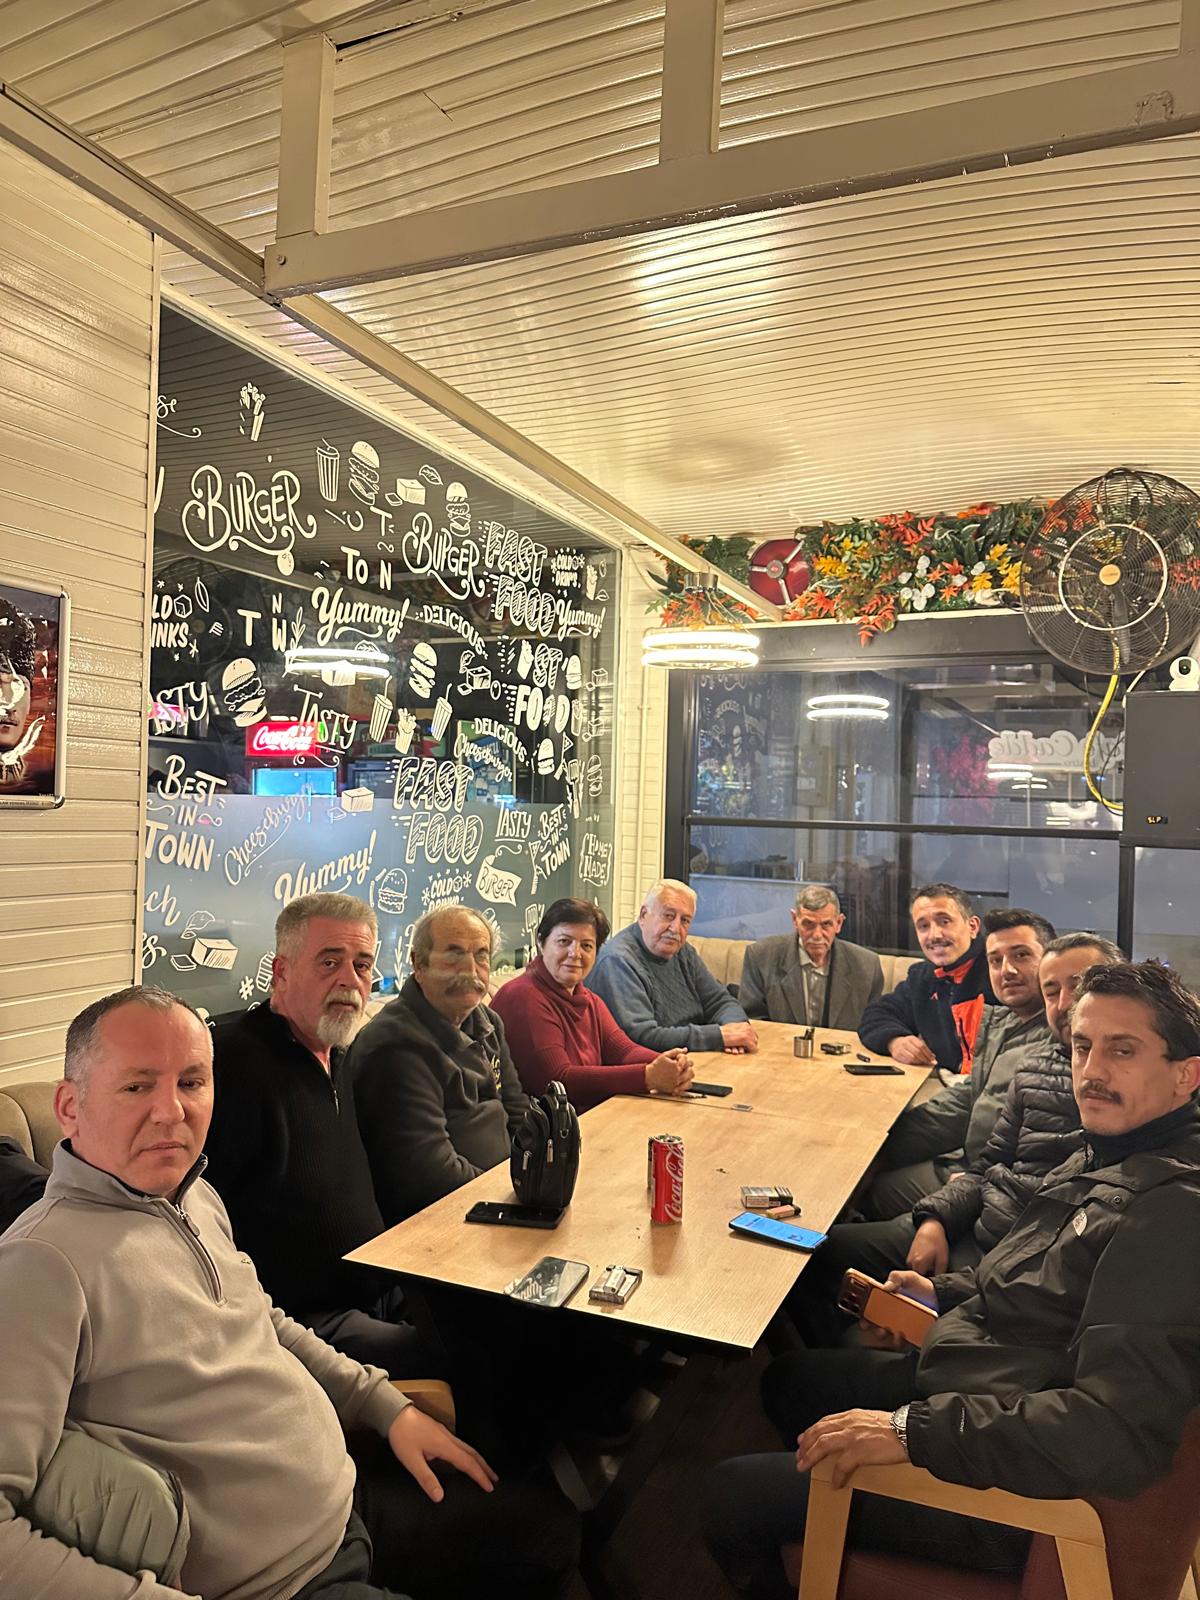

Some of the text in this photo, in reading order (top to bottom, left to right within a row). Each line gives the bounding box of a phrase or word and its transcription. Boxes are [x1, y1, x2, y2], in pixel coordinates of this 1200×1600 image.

[485, 521, 548, 587] FAST
[311, 586, 411, 647] Yummy!
[495, 574, 556, 637] FOOD
[293, 684, 358, 750] TASTY
[157, 754, 228, 807] BEST
[393, 756, 475, 813] FAST
[178, 804, 199, 827] IN
[405, 812, 484, 866] FOOD
[145, 819, 215, 872] TOWN
